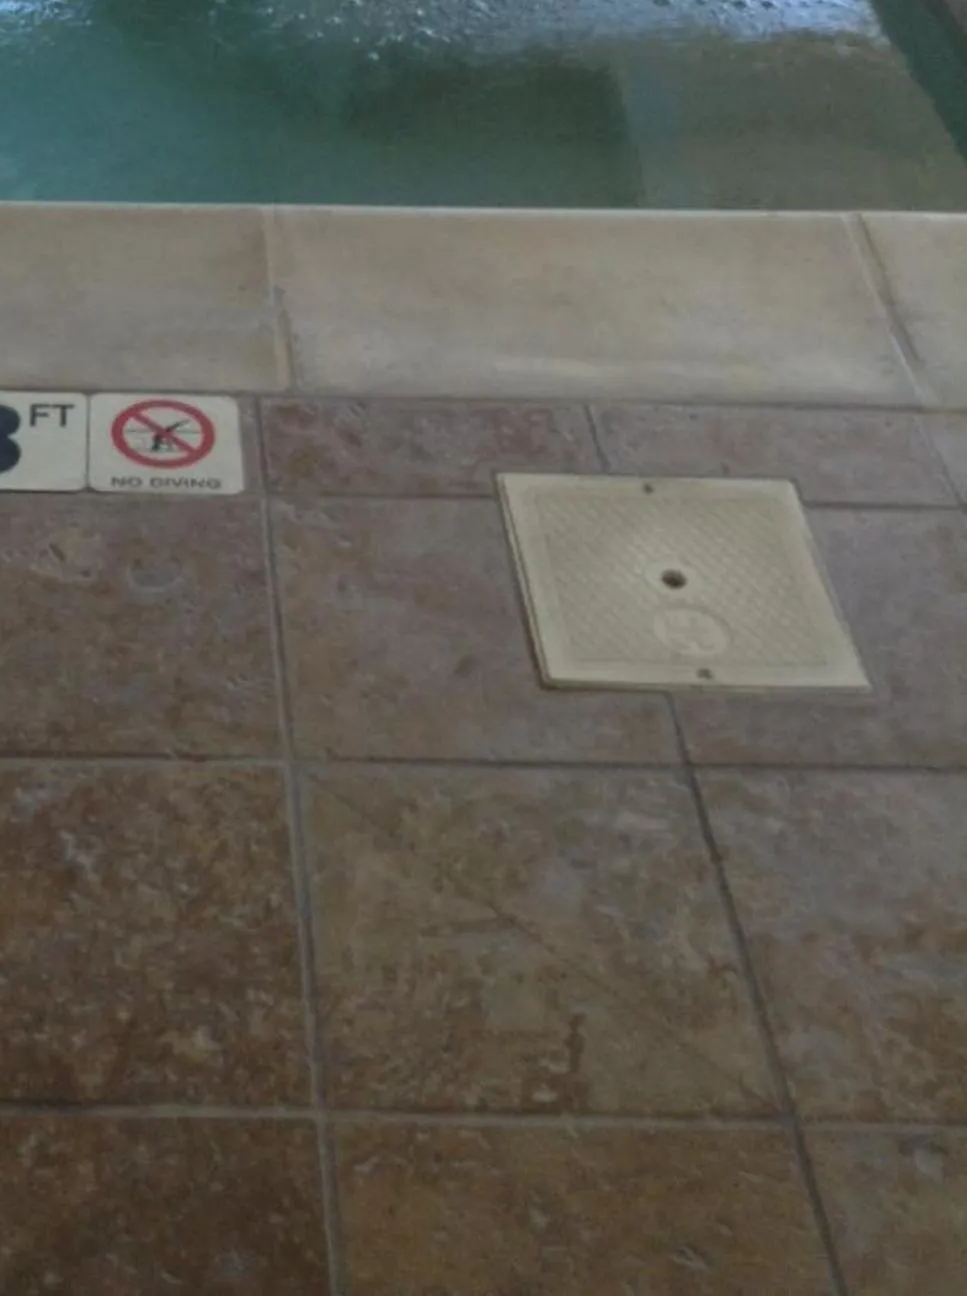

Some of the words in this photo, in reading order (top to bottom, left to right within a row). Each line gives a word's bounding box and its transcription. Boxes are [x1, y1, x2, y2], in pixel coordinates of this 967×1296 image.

[28, 403, 75, 428] FT
[110, 476, 143, 488] NO
[150, 476, 223, 490] DIVING
